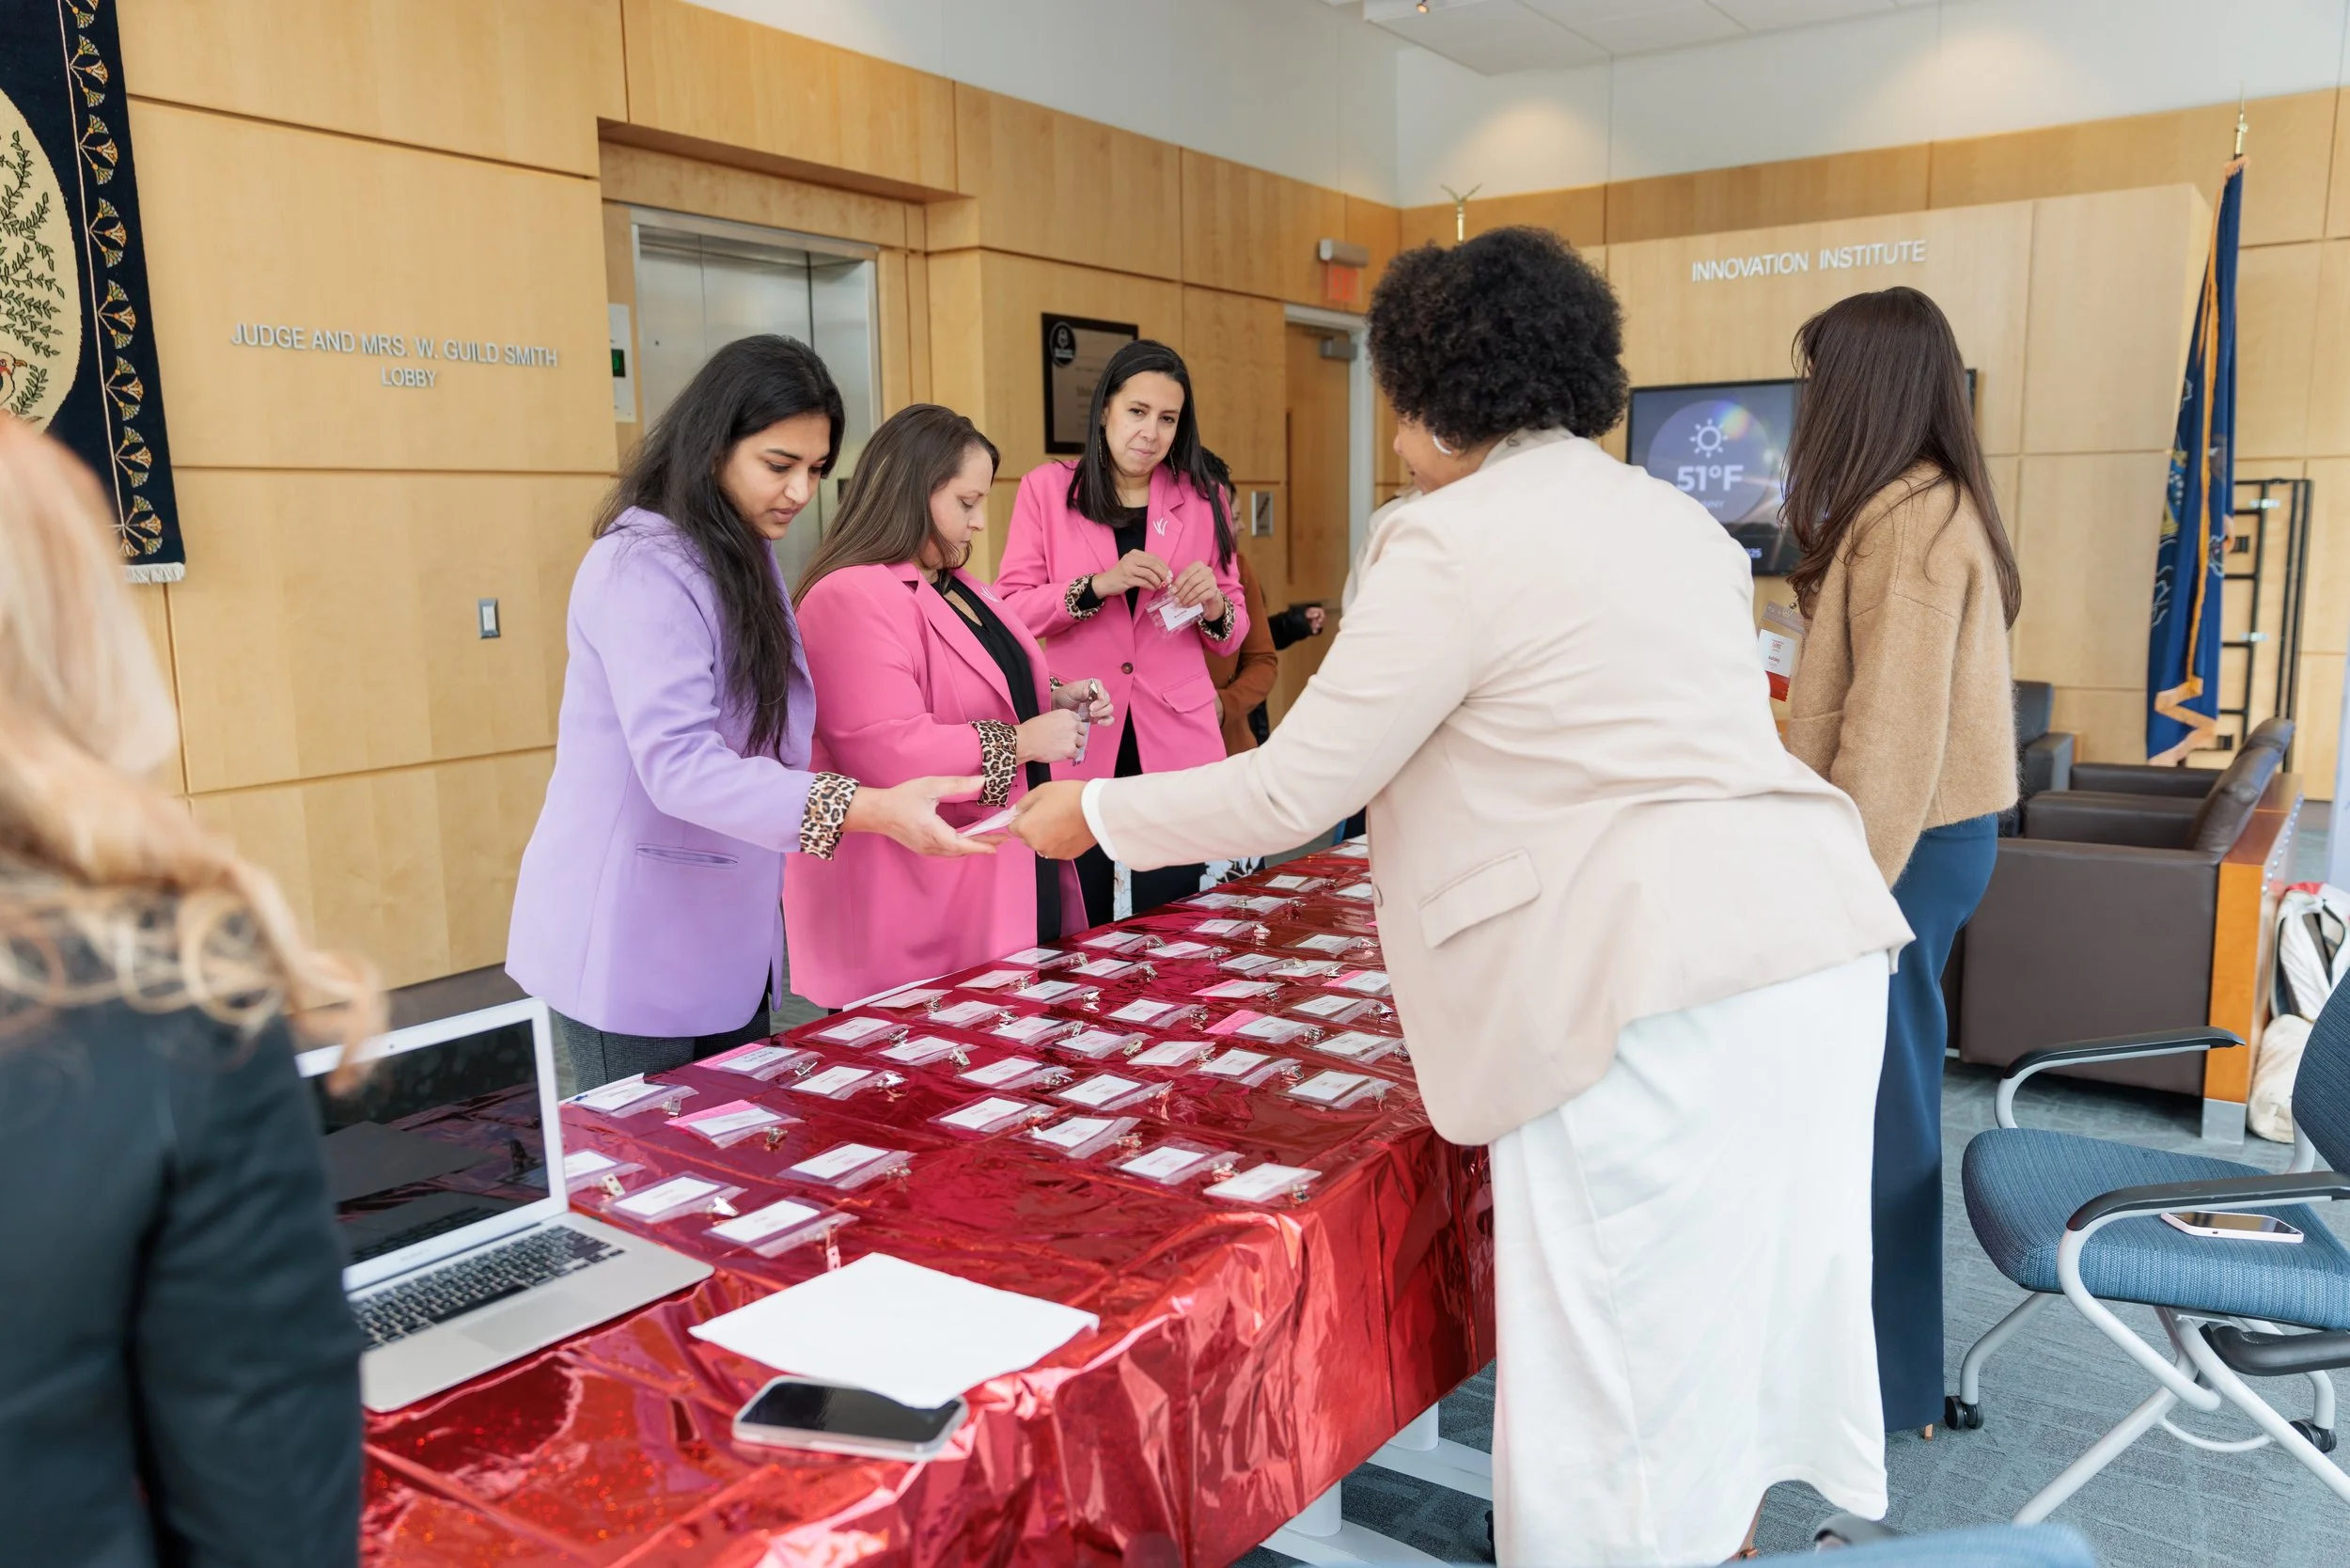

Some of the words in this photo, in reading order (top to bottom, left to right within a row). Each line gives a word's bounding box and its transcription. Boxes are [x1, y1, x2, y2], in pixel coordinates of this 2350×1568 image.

[1692, 251, 1809, 282] INNOVATION
[1819, 240, 1927, 270] INSTITUTE
[231, 323, 306, 350] JUDGE
[311, 330, 355, 353] AND
[361, 333, 410, 357] MRS.
[415, 337, 438, 359] W.
[443, 339, 499, 364] GUILD
[504, 344, 557, 367] SMITH
[381, 368, 436, 387] LOBBY
[1677, 464, 1744, 492] 51°F
